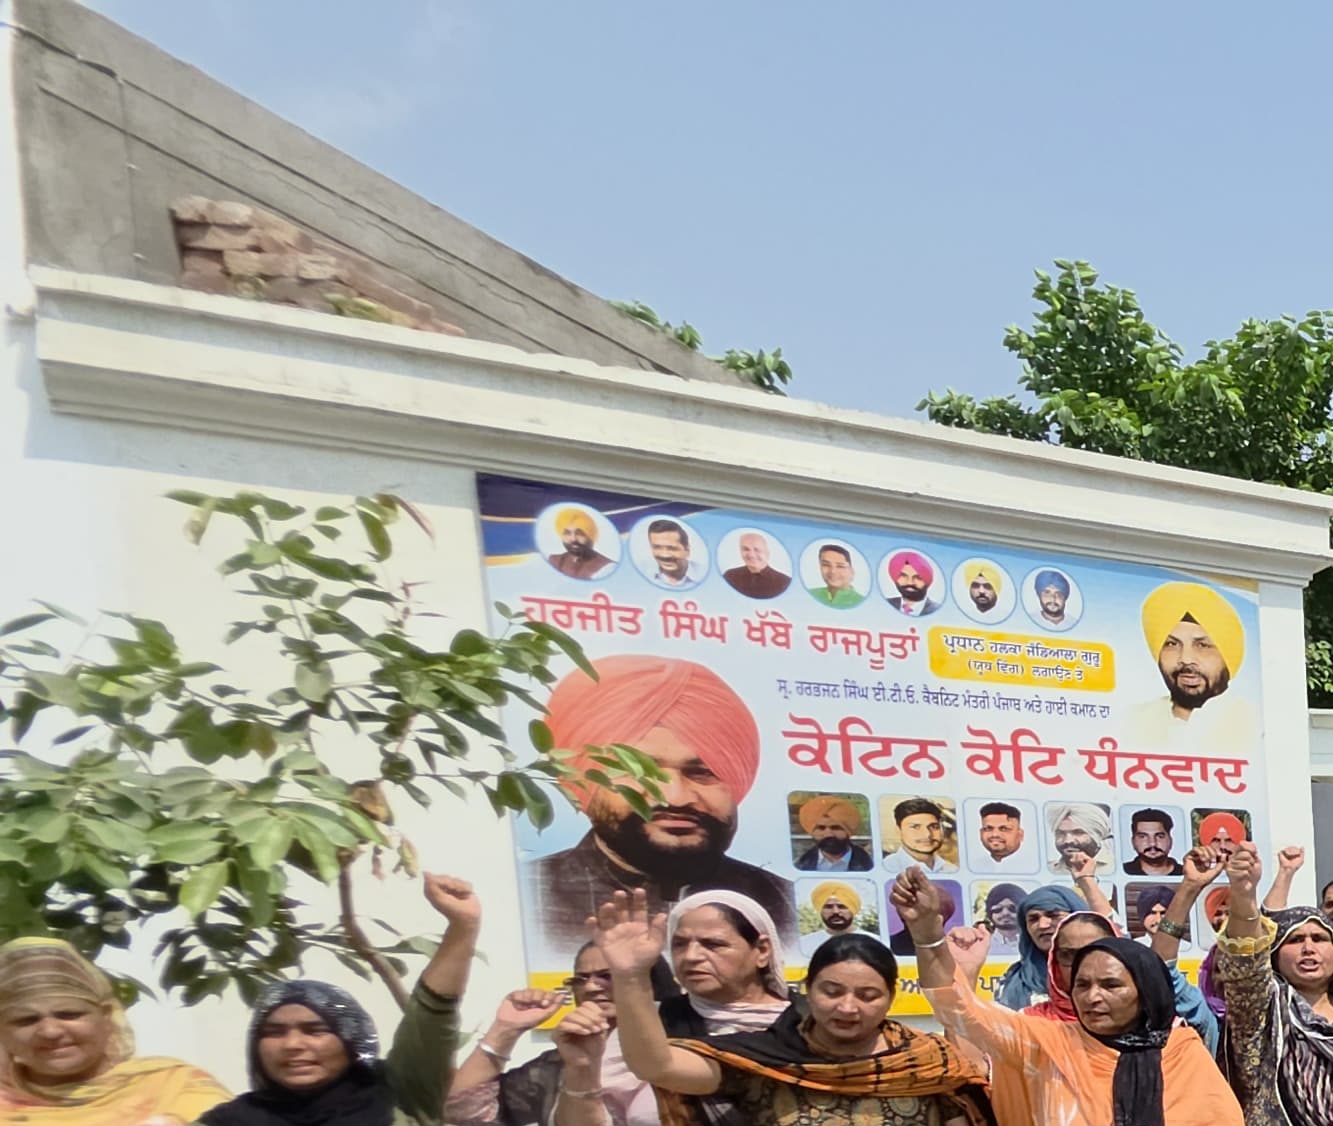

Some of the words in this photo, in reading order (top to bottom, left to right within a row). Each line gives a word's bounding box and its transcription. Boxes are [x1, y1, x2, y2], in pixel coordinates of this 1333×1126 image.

[520, 592, 644, 635] ਹਰਜੀਤ
[660, 600, 728, 643] ਸਿੰਘ
[743, 608, 793, 650] ਖੱਬੇ
[808, 625, 920, 670] ਰਾਜਪੂਤਾਂ
[795, 681, 841, 699] ਹਰਭਜਨ
[843, 678, 869, 700] ਸਿੰਘ
[962, 689, 990, 710] ਮੰਤਰੀ
[992, 692, 1021, 712] ਪੰਜਾਬ
[1024, 694, 1042, 714] ਅਤੇ
[1099, 705, 1110, 719] ਦਾ
[781, 711, 948, 780] ਕੋਟਿਨ
[960, 724, 1065, 785] ਕੋਟਿ
[1077, 736, 1249, 795] ਧੰਨਵਾਦ
